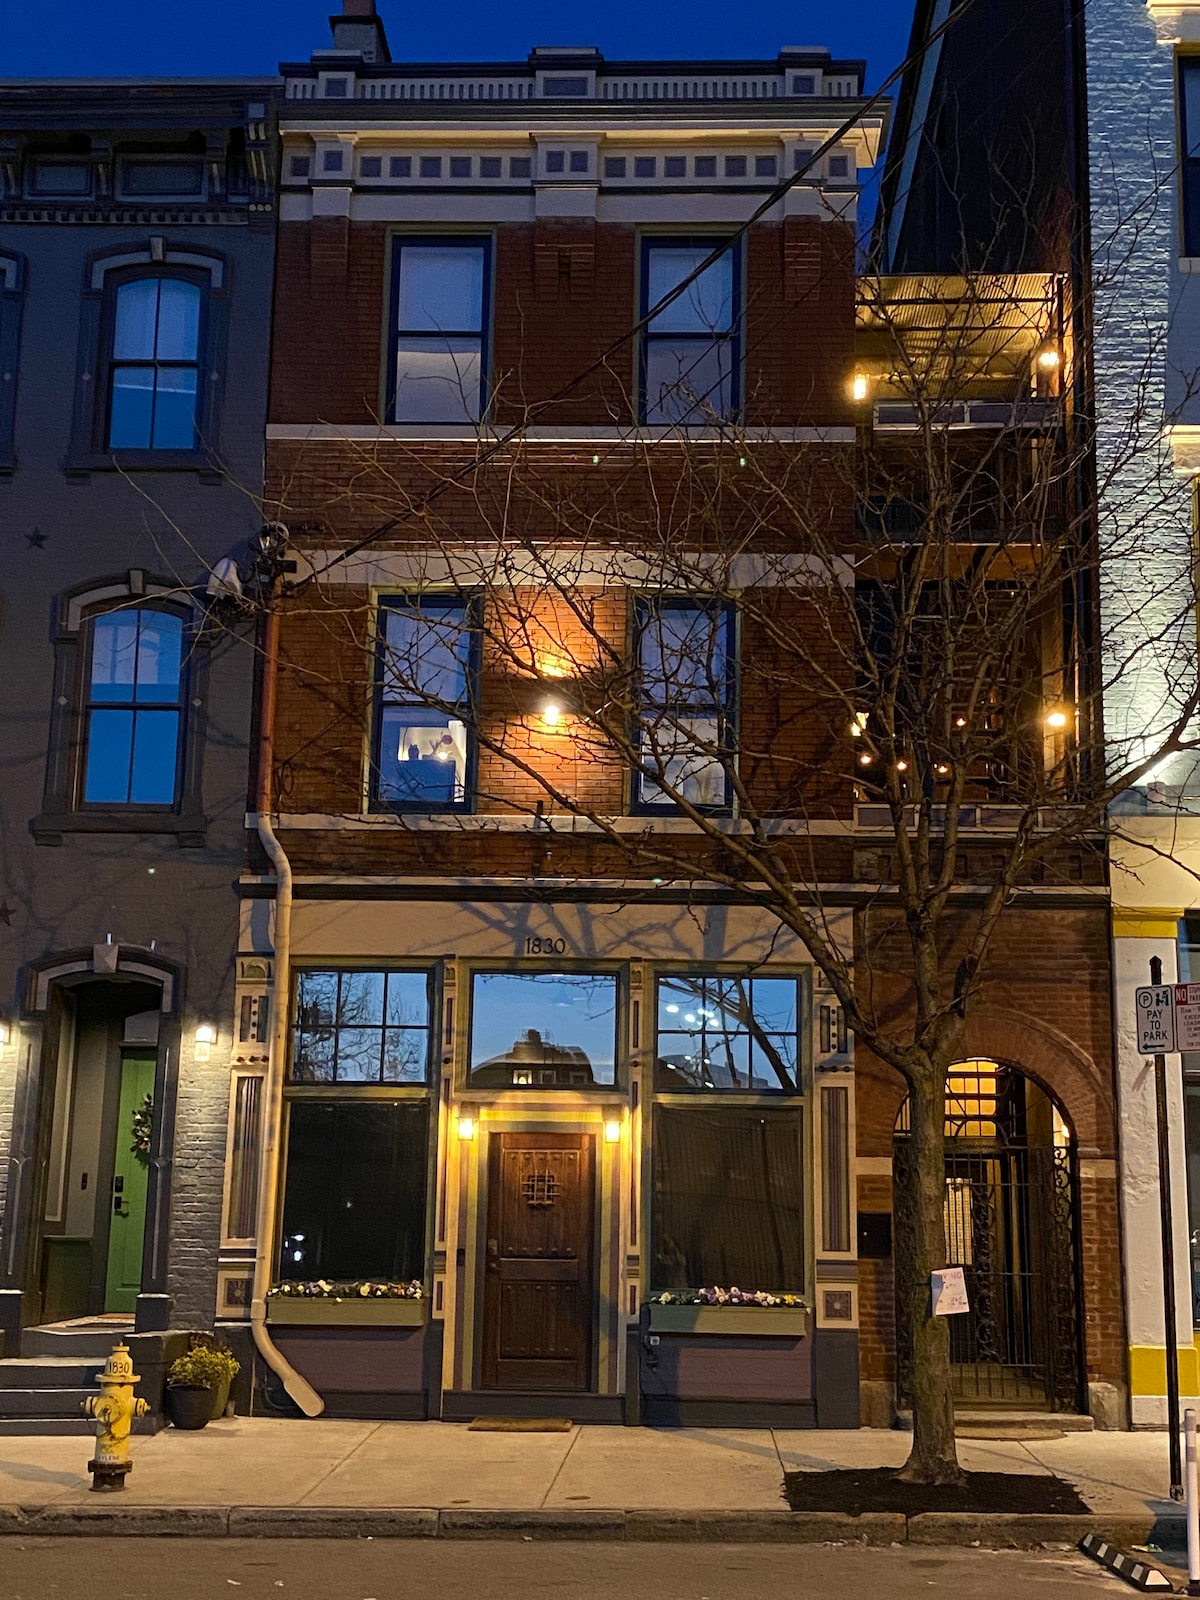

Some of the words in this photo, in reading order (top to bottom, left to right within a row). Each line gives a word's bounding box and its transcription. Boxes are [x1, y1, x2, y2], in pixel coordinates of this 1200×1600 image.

[526, 937, 566, 954] 1830
[1143, 995, 1149, 1006] P
[1175, 988, 1187, 1002] NO
[1146, 1010, 1163, 1020] PAY
[1149, 1020, 1161, 1030] TO
[1143, 1030, 1168, 1041] PARK
[109, 1361, 130, 1374] 1830
